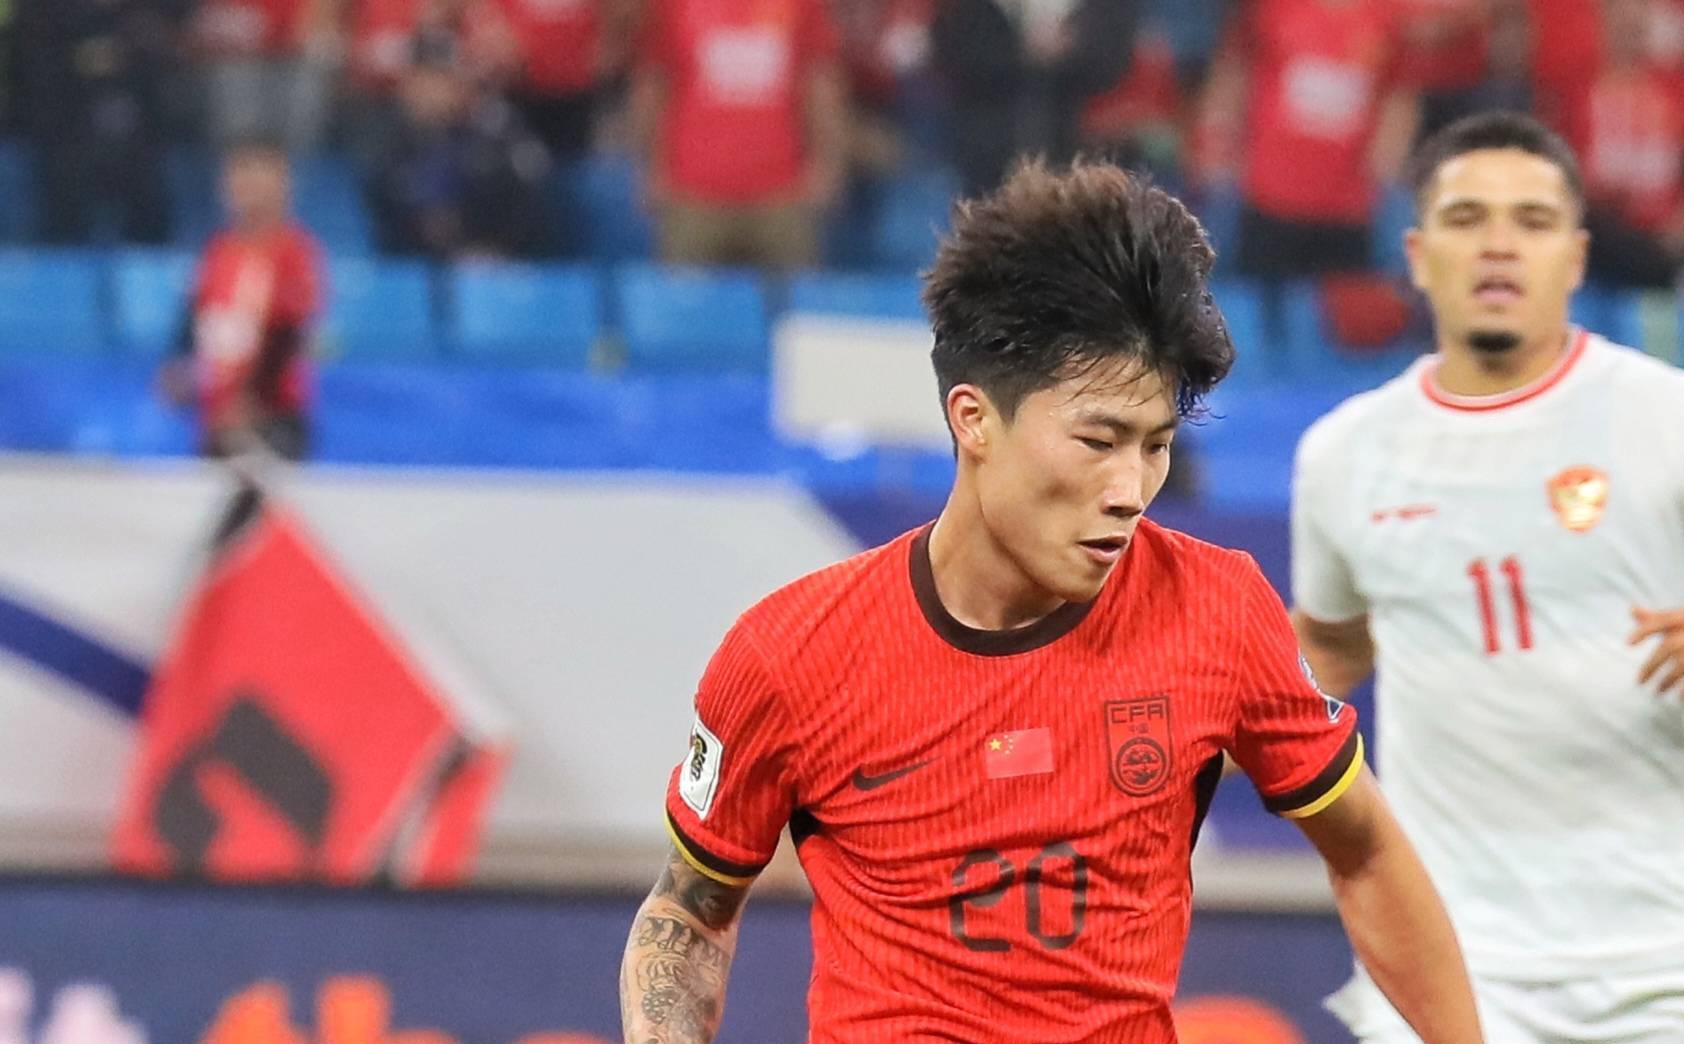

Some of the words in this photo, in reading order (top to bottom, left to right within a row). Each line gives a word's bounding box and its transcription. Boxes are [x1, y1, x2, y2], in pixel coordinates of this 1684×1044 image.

[1467, 555, 1534, 655] 11
[1110, 703, 1165, 724] CFA
[949, 840, 1088, 954] 20
